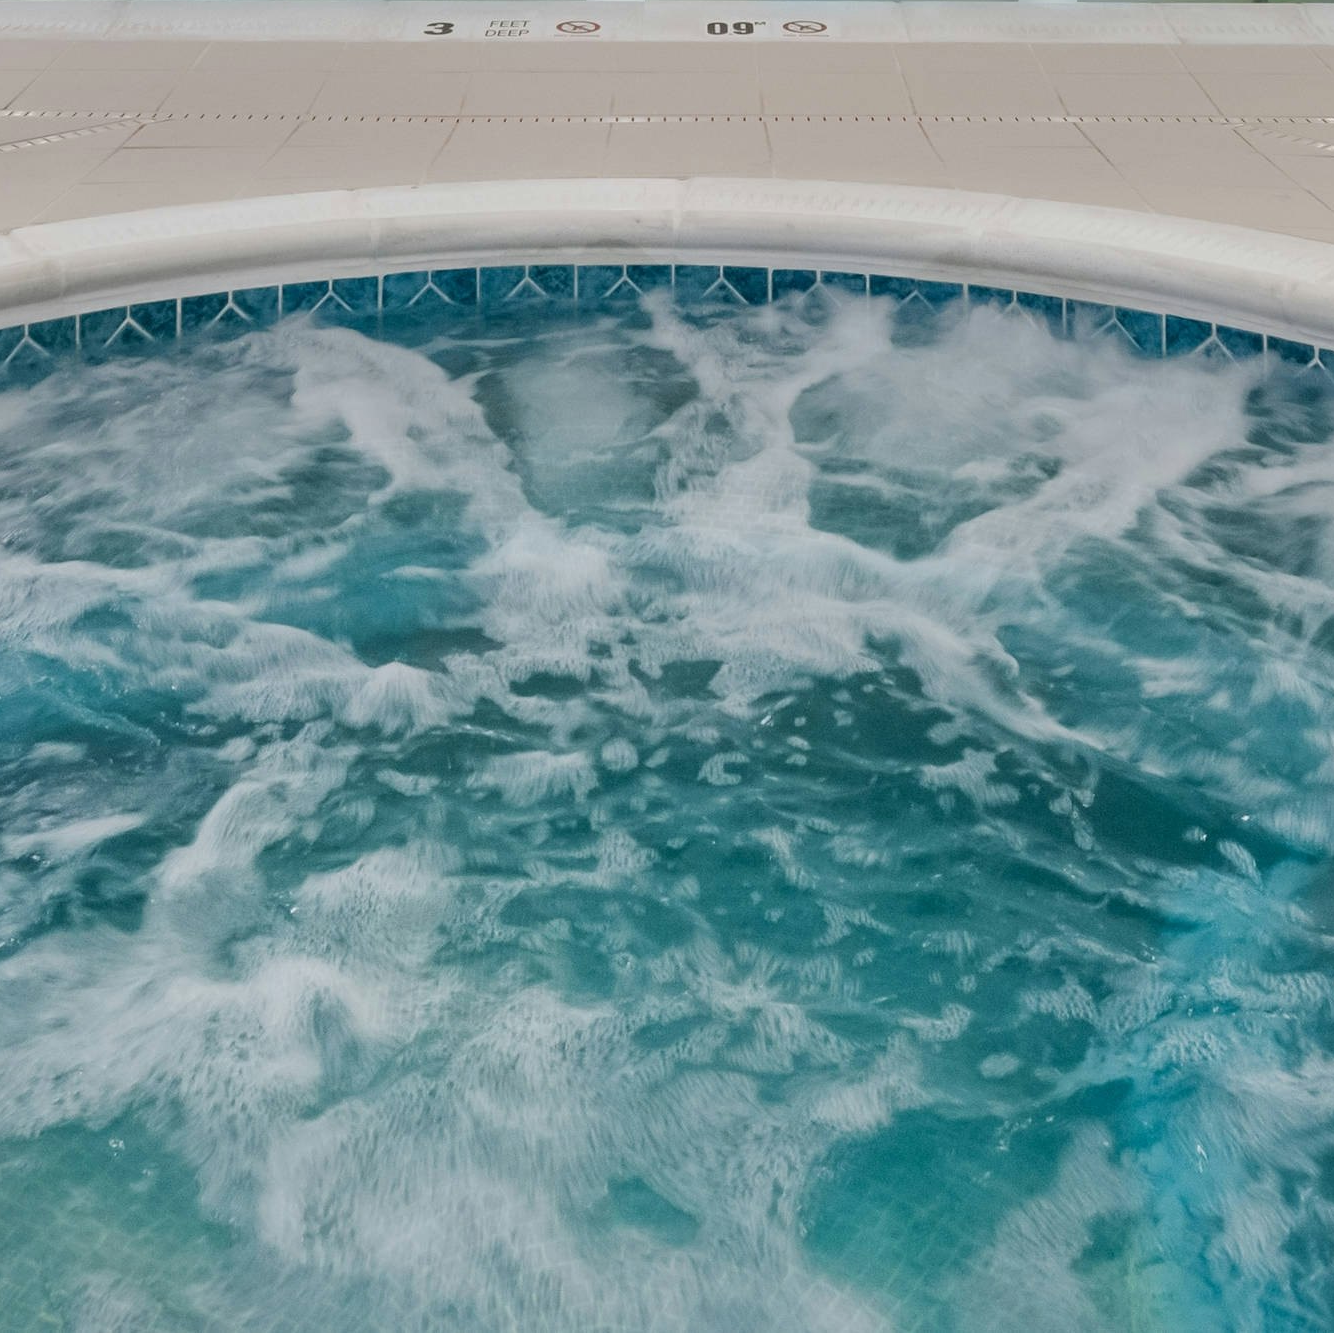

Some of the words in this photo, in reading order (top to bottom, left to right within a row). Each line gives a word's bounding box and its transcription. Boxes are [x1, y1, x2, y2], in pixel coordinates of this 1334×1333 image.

[423, 22, 455, 35] 3
[484, 29, 530, 37] DEEP
[489, 20, 531, 28] FEET
